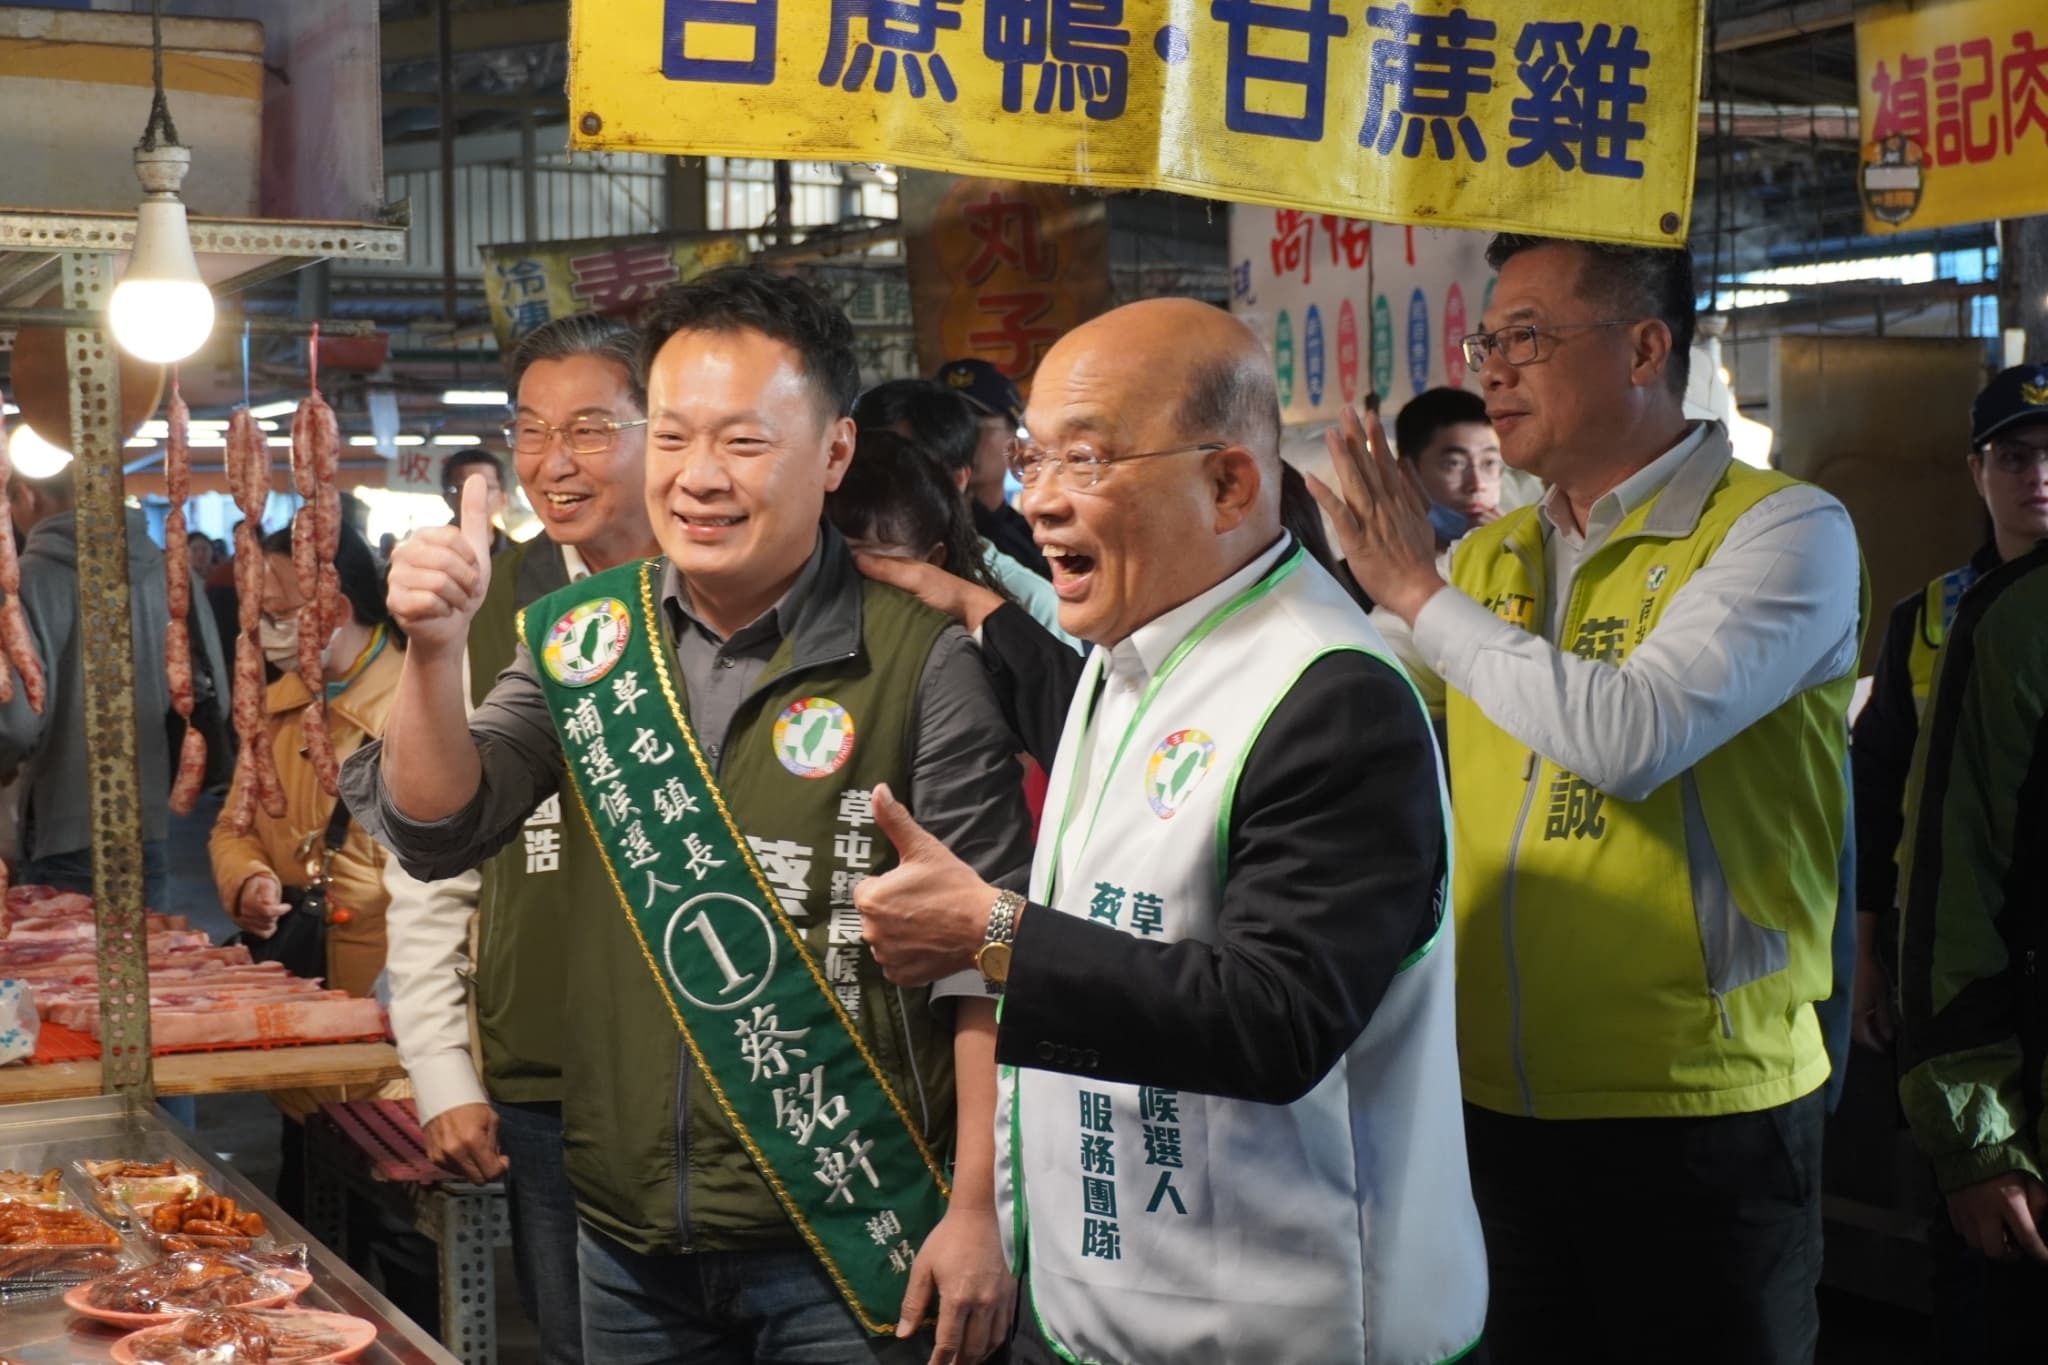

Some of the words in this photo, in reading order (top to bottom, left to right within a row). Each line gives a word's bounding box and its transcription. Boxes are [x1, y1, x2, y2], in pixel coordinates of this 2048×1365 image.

[962, 192, 1058, 377] 丸子
[563, 692, 681, 909] 補選候選人
[611, 670, 726, 881] 草屯鎮長
[1543, 770, 1606, 841] 誠
[733, 1003, 881, 1206] 蔡銘軒
[1080, 1090, 1121, 1261] 服務團隊
